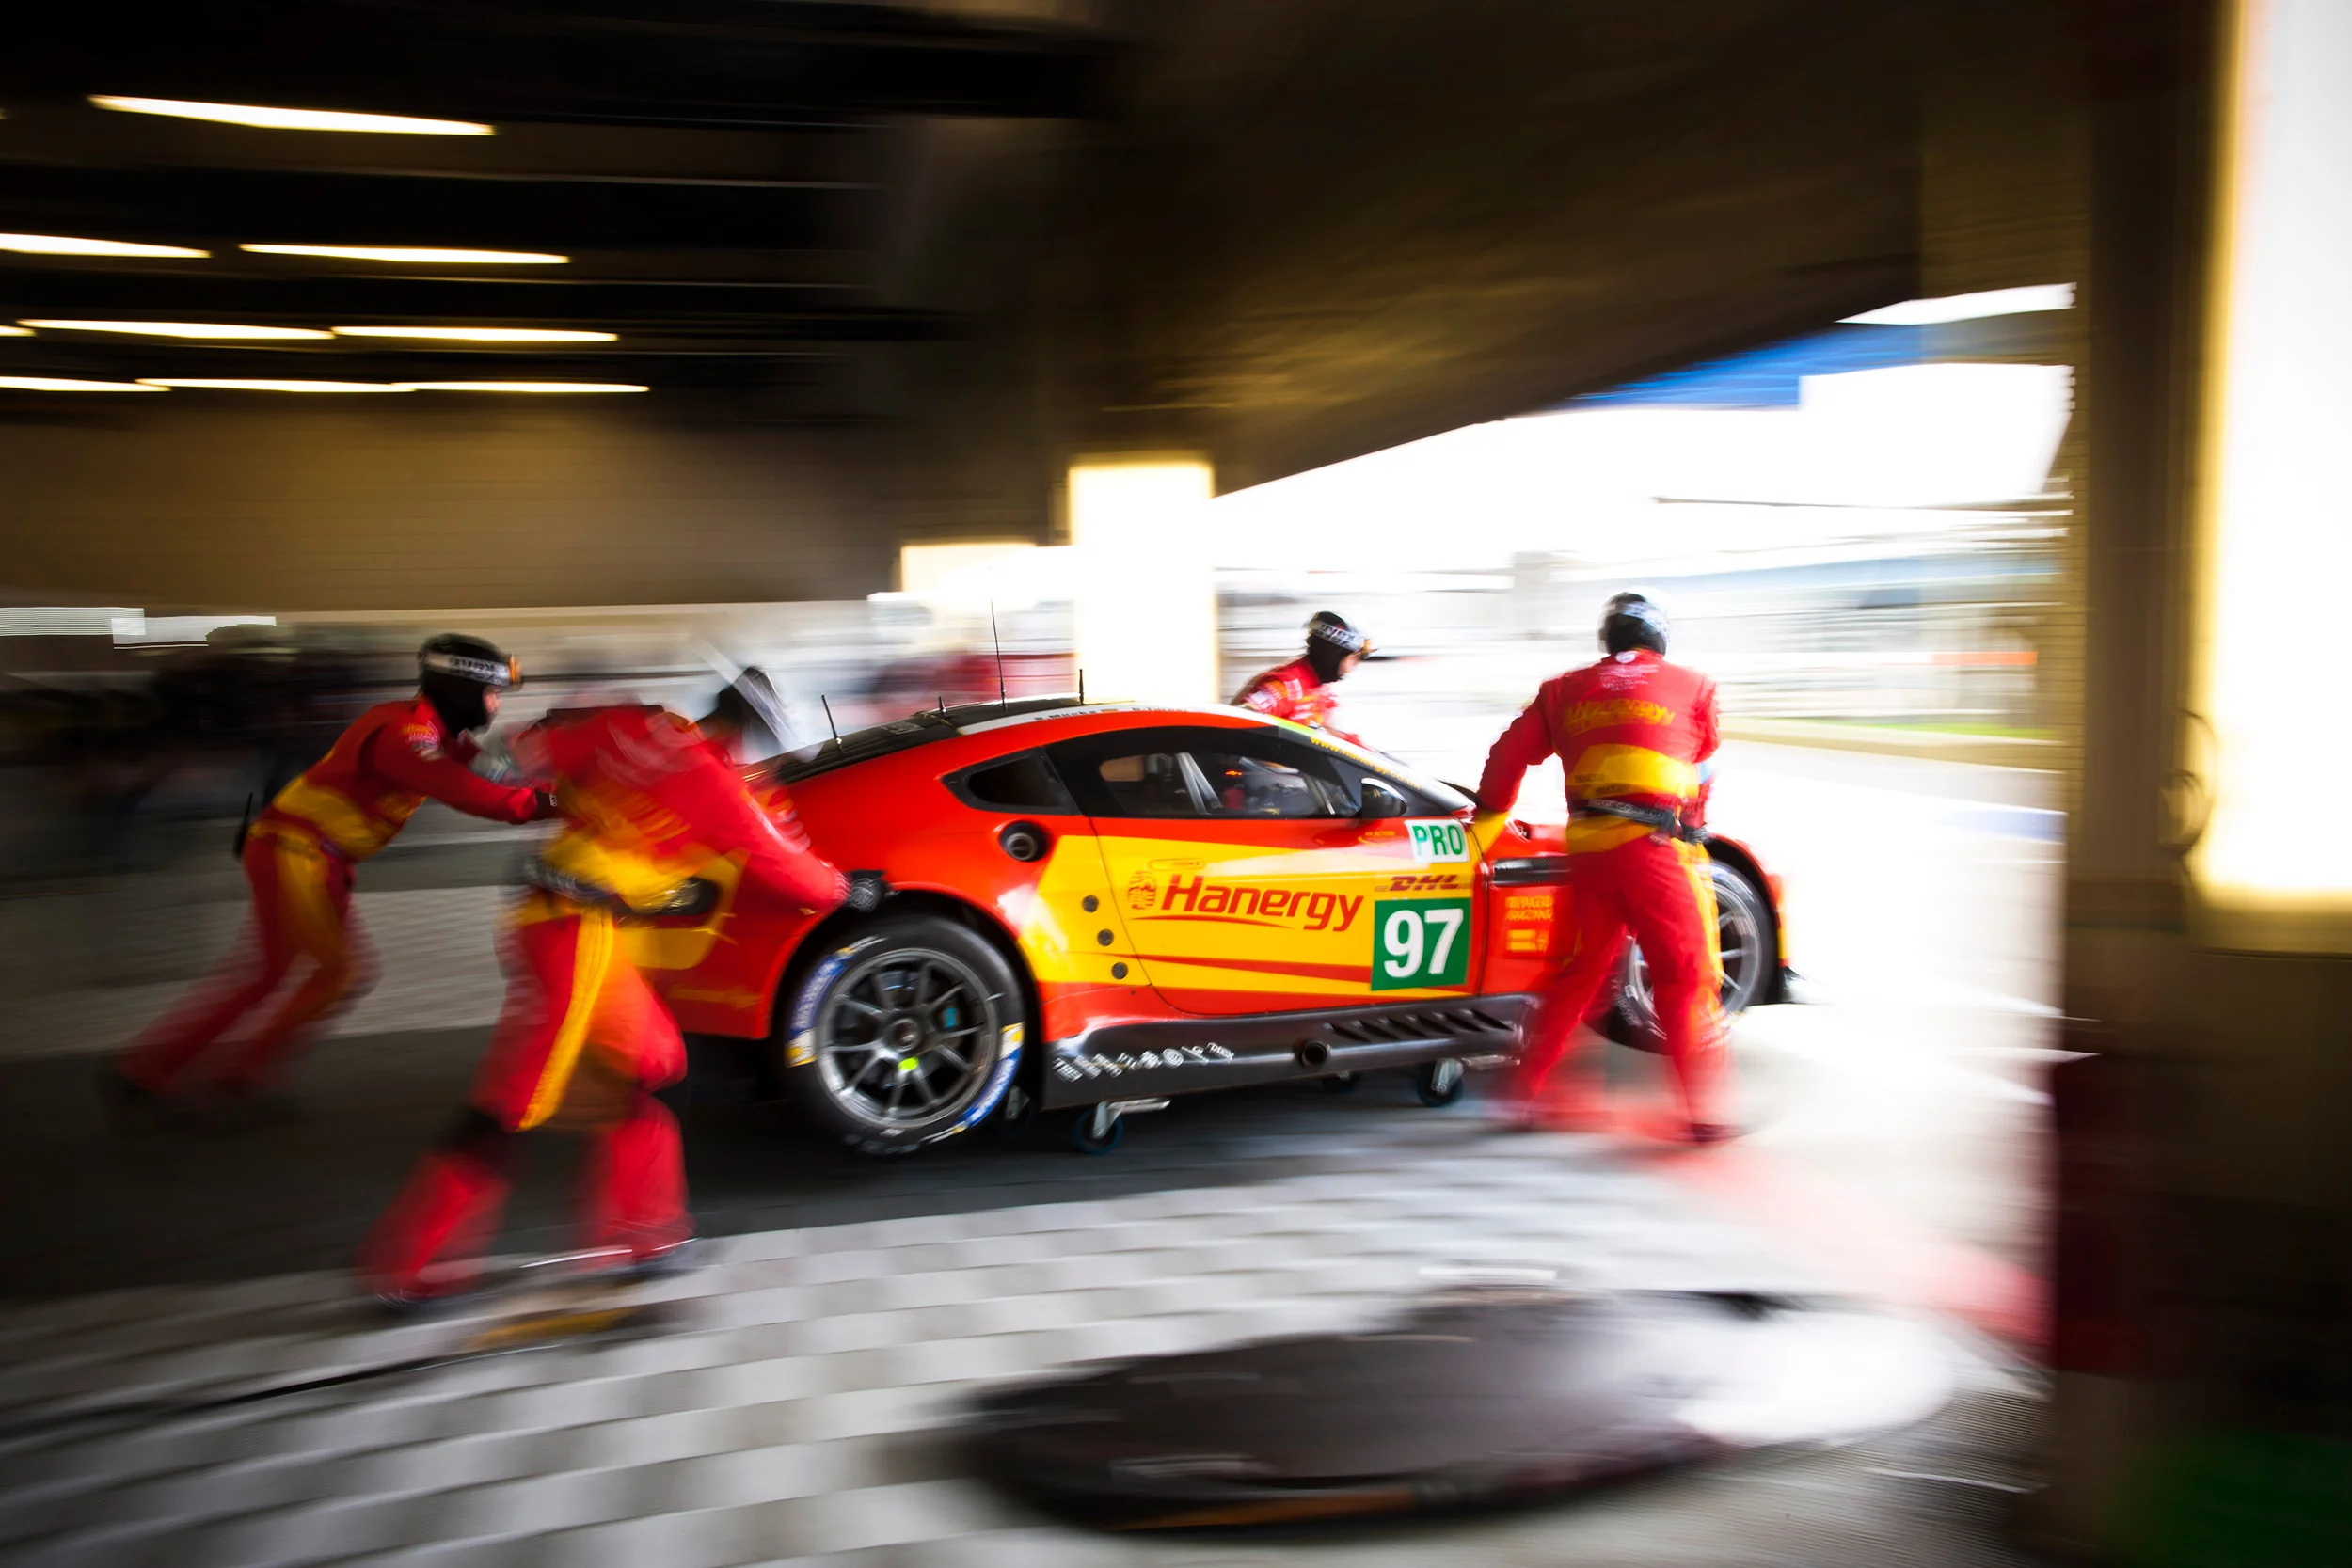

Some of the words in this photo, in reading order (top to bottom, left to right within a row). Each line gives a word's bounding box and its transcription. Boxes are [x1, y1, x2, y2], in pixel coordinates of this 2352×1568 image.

[1412, 825, 1464, 856] PRO
[1161, 874, 1364, 931] Hanergy
[1390, 874, 1459, 892] DHL
[1384, 908, 1464, 978] 97
